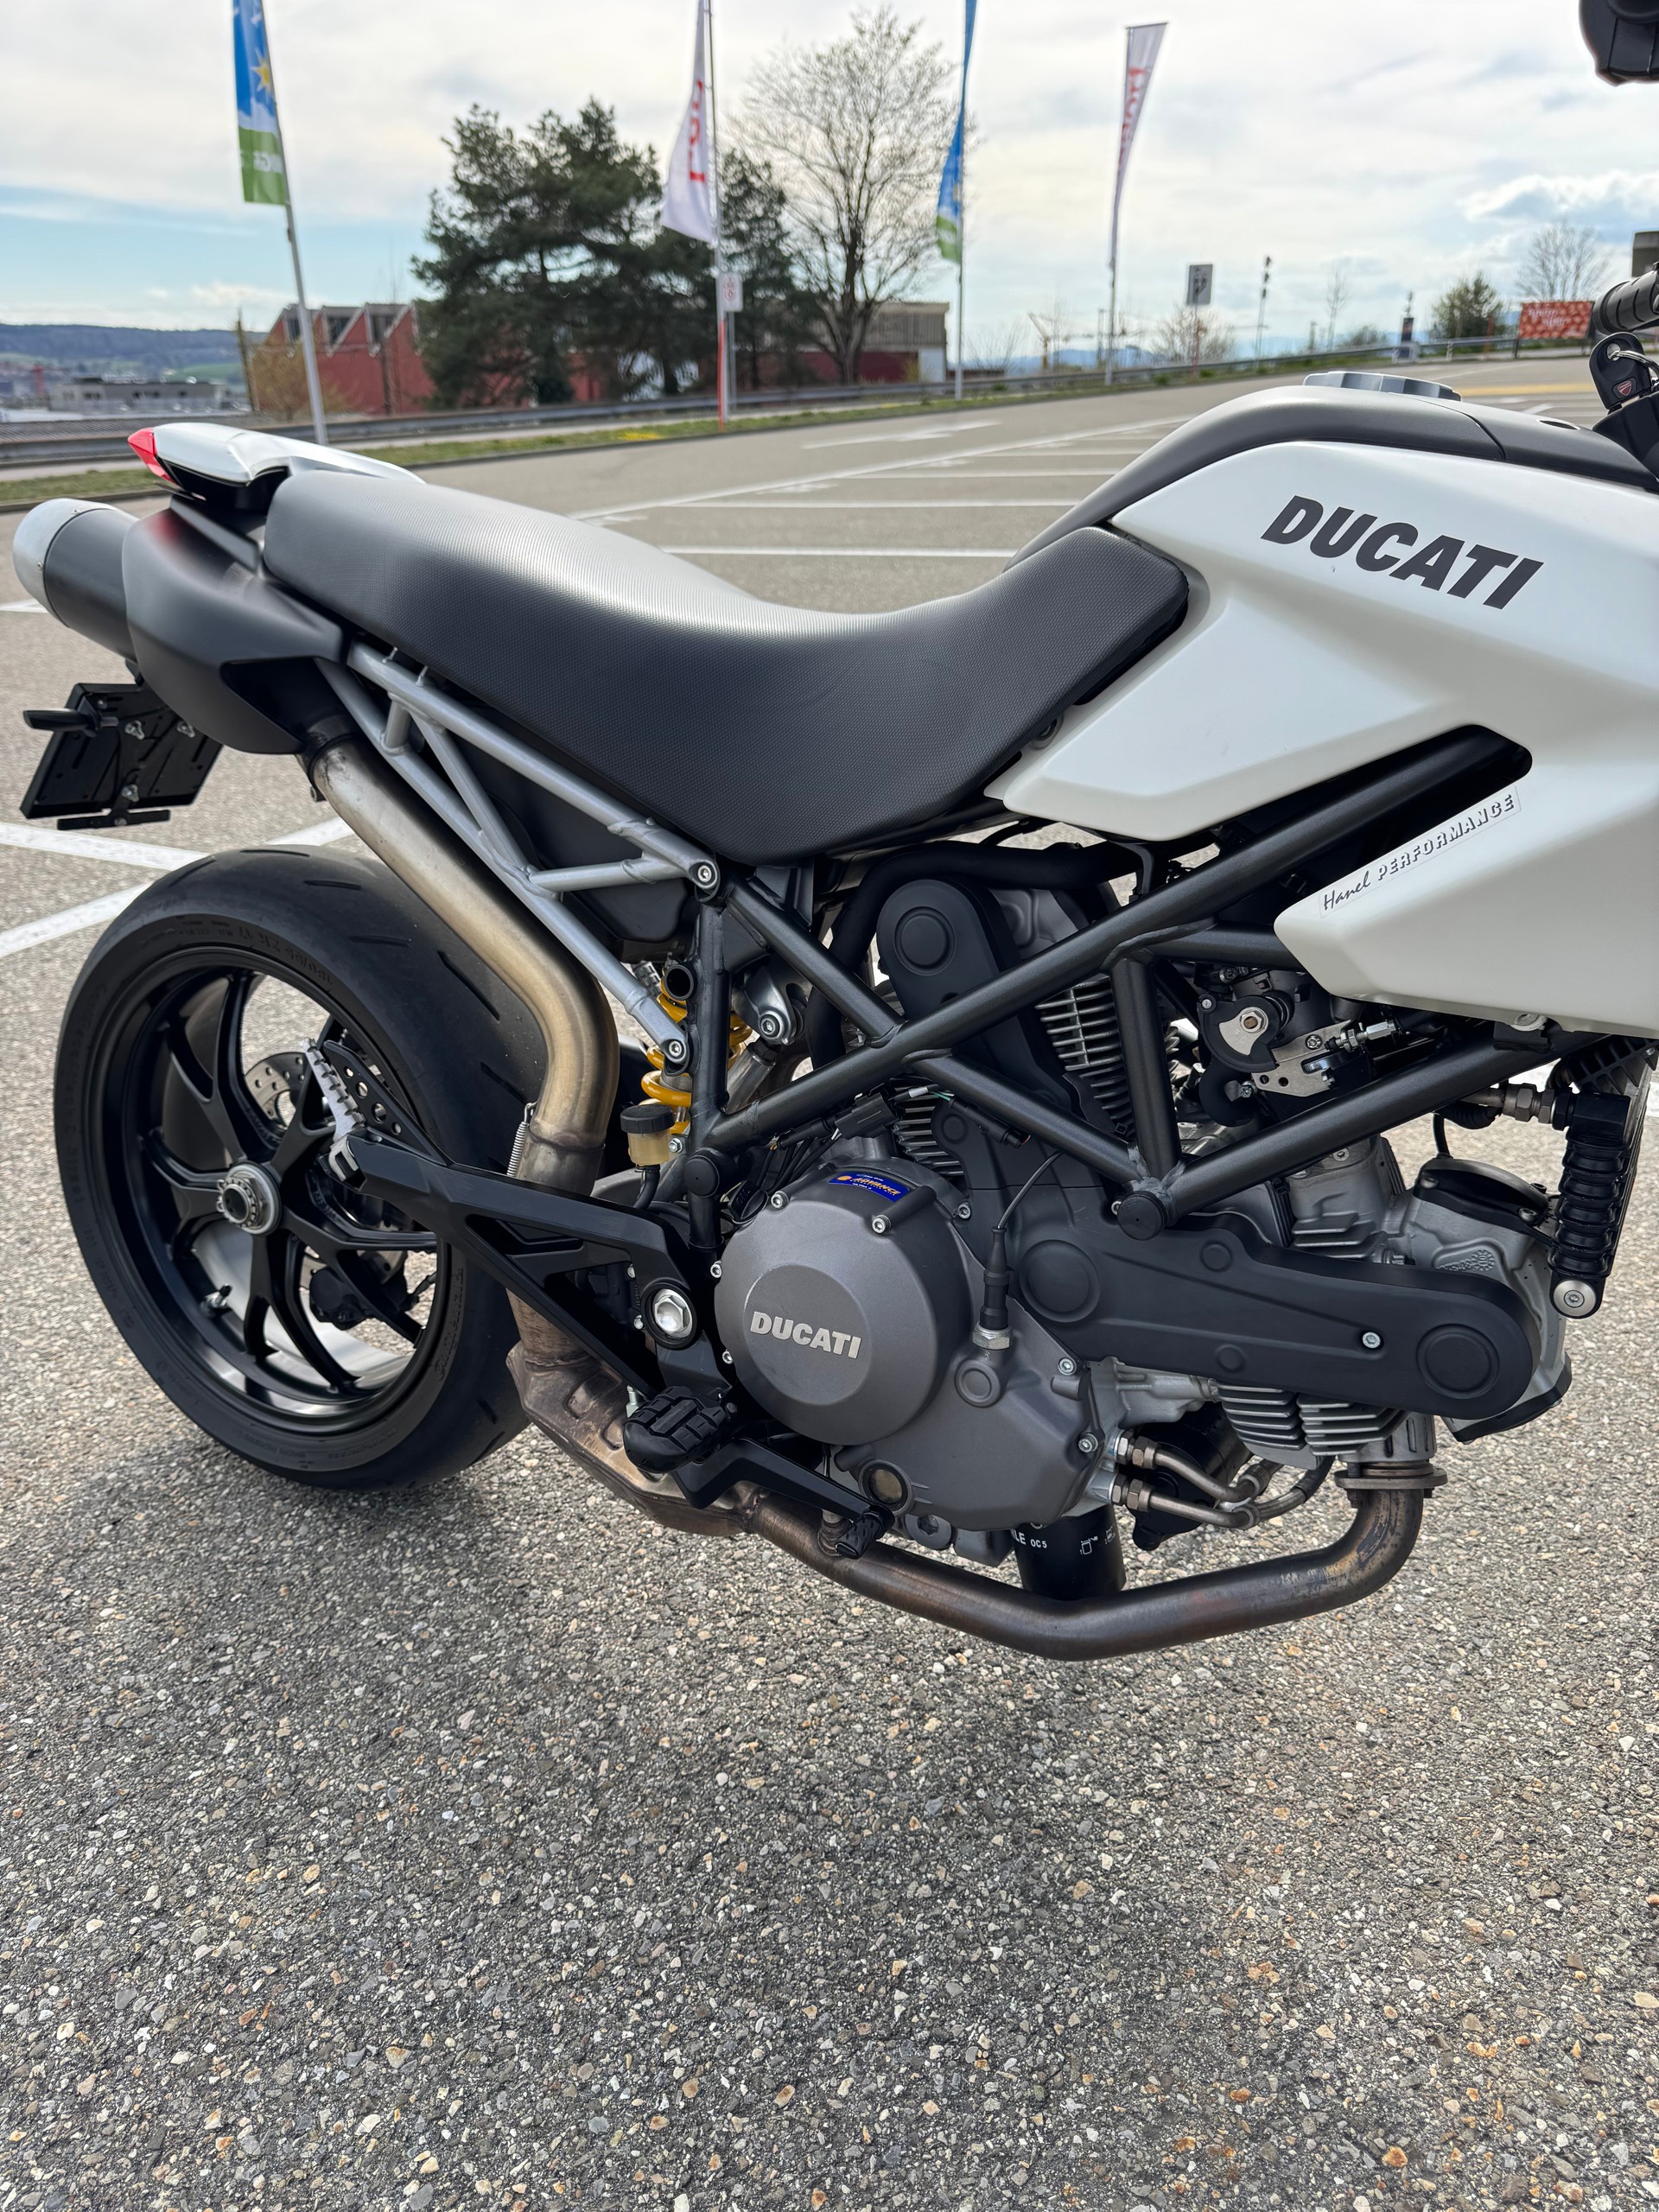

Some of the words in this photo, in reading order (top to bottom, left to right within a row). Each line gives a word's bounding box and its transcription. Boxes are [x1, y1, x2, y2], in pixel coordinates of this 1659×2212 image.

[1261, 495, 1544, 610] DUCATI
[1377, 794, 1515, 881] PERFORMANCE
[852, 1177, 901, 1195] ADVANCE
[750, 1311, 861, 1359] DUCATI
